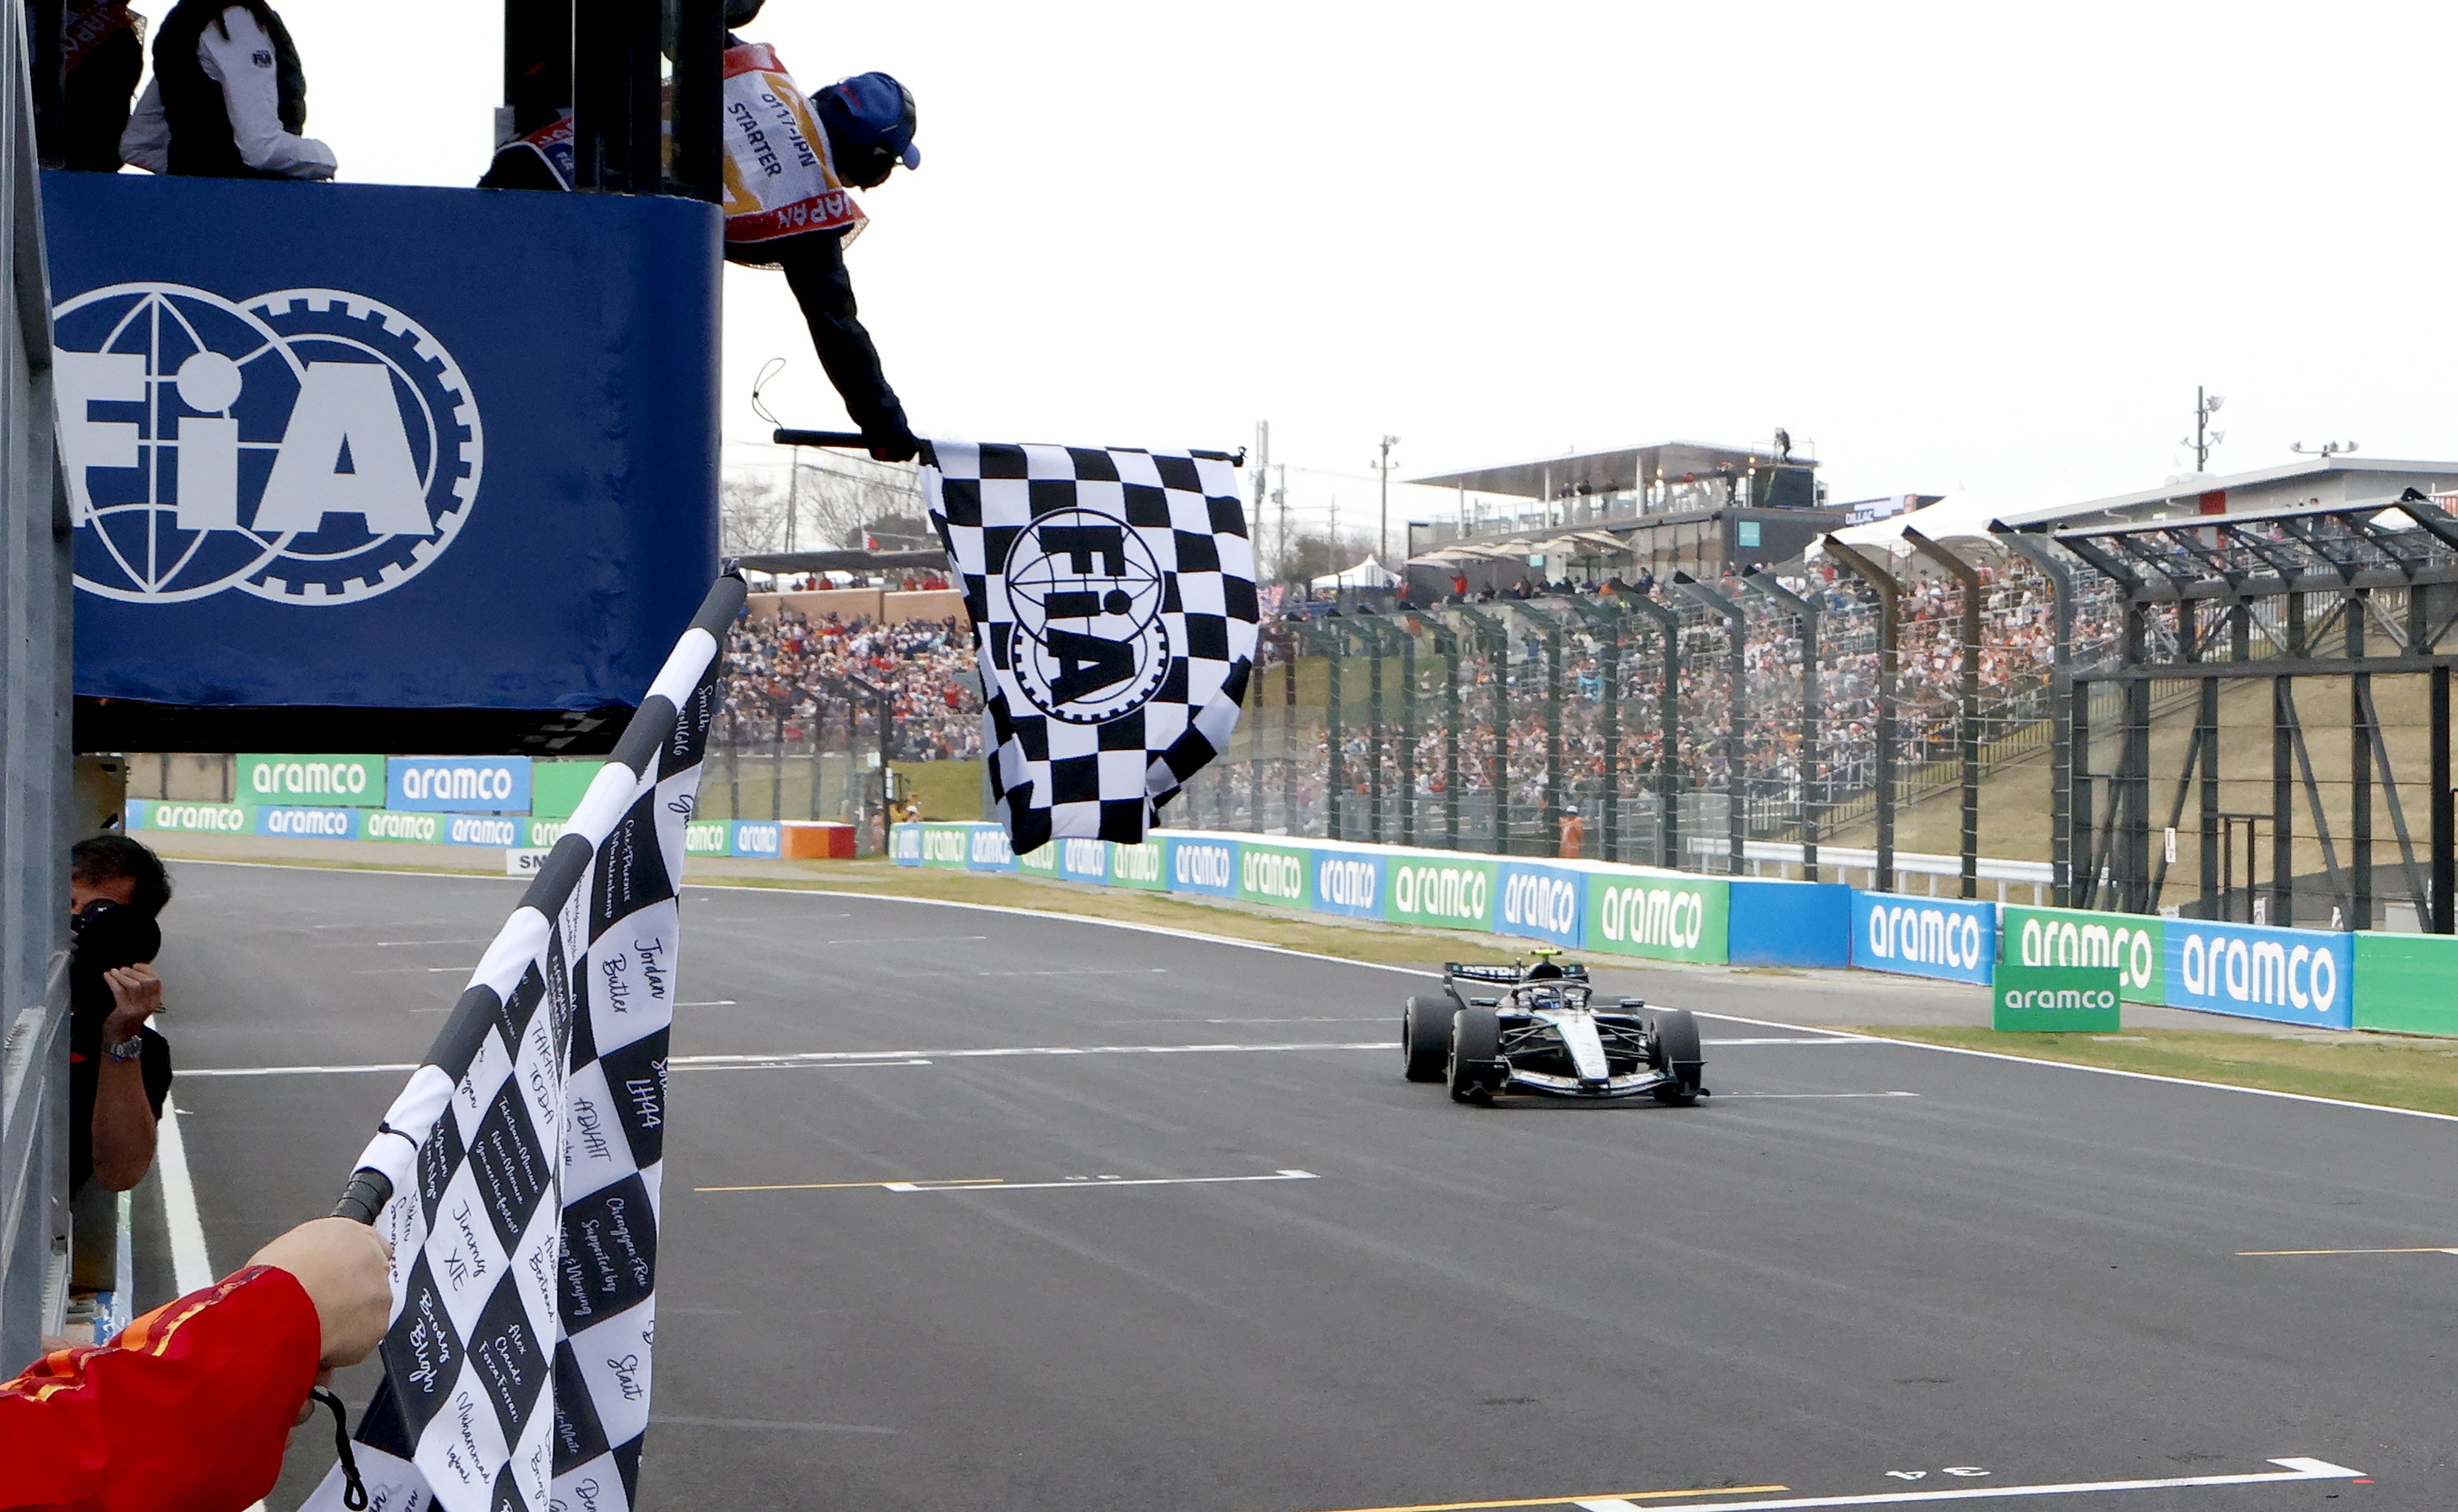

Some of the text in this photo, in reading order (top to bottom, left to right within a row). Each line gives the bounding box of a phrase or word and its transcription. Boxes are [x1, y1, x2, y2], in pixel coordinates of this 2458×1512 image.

[729, 103, 782, 178] STARTER
[779, 193, 850, 229] JAPAN
[253, 764, 366, 794] aramco
[403, 769, 512, 799] aramco
[156, 806, 244, 830] aramco
[269, 810, 347, 835] aramco
[368, 814, 436, 840] aramco
[452, 819, 514, 845] aramco
[532, 822, 566, 847] ara
[686, 825, 724, 851] amco
[1176, 845, 1230, 888] aramco
[1244, 852, 1302, 899] aramco
[1396, 866, 1486, 920] aramco
[1505, 872, 1574, 934] aramco
[1602, 886, 1702, 949] aramco
[1870, 904, 1980, 969] aramco
[2021, 919, 2152, 989] aramco
[603, 954, 630, 1013] Butler
[634, 938, 666, 999] Jordan
[2183, 934, 2336, 1012] aramco
[2004, 990, 2114, 1009] aramco
[530, 1064, 554, 1124] TODA
[626, 1079, 663, 1129] LH44
[574, 1097, 612, 1162] ADVAIT
[492, 1178, 506, 1200] the
[452, 1199, 487, 1278] Jimmy
[581, 1219, 618, 1293] Supported by
[444, 1247, 469, 1291] XIE
[419, 1288, 450, 1363] Brody
[508, 1324, 527, 1355] Alex
[409, 1317, 436, 1392] Bligh
[495, 1336, 521, 1385] Claude
[478, 1340, 519, 1423] Forza Ferrari
[456, 1391, 490, 1484] Muhammad
